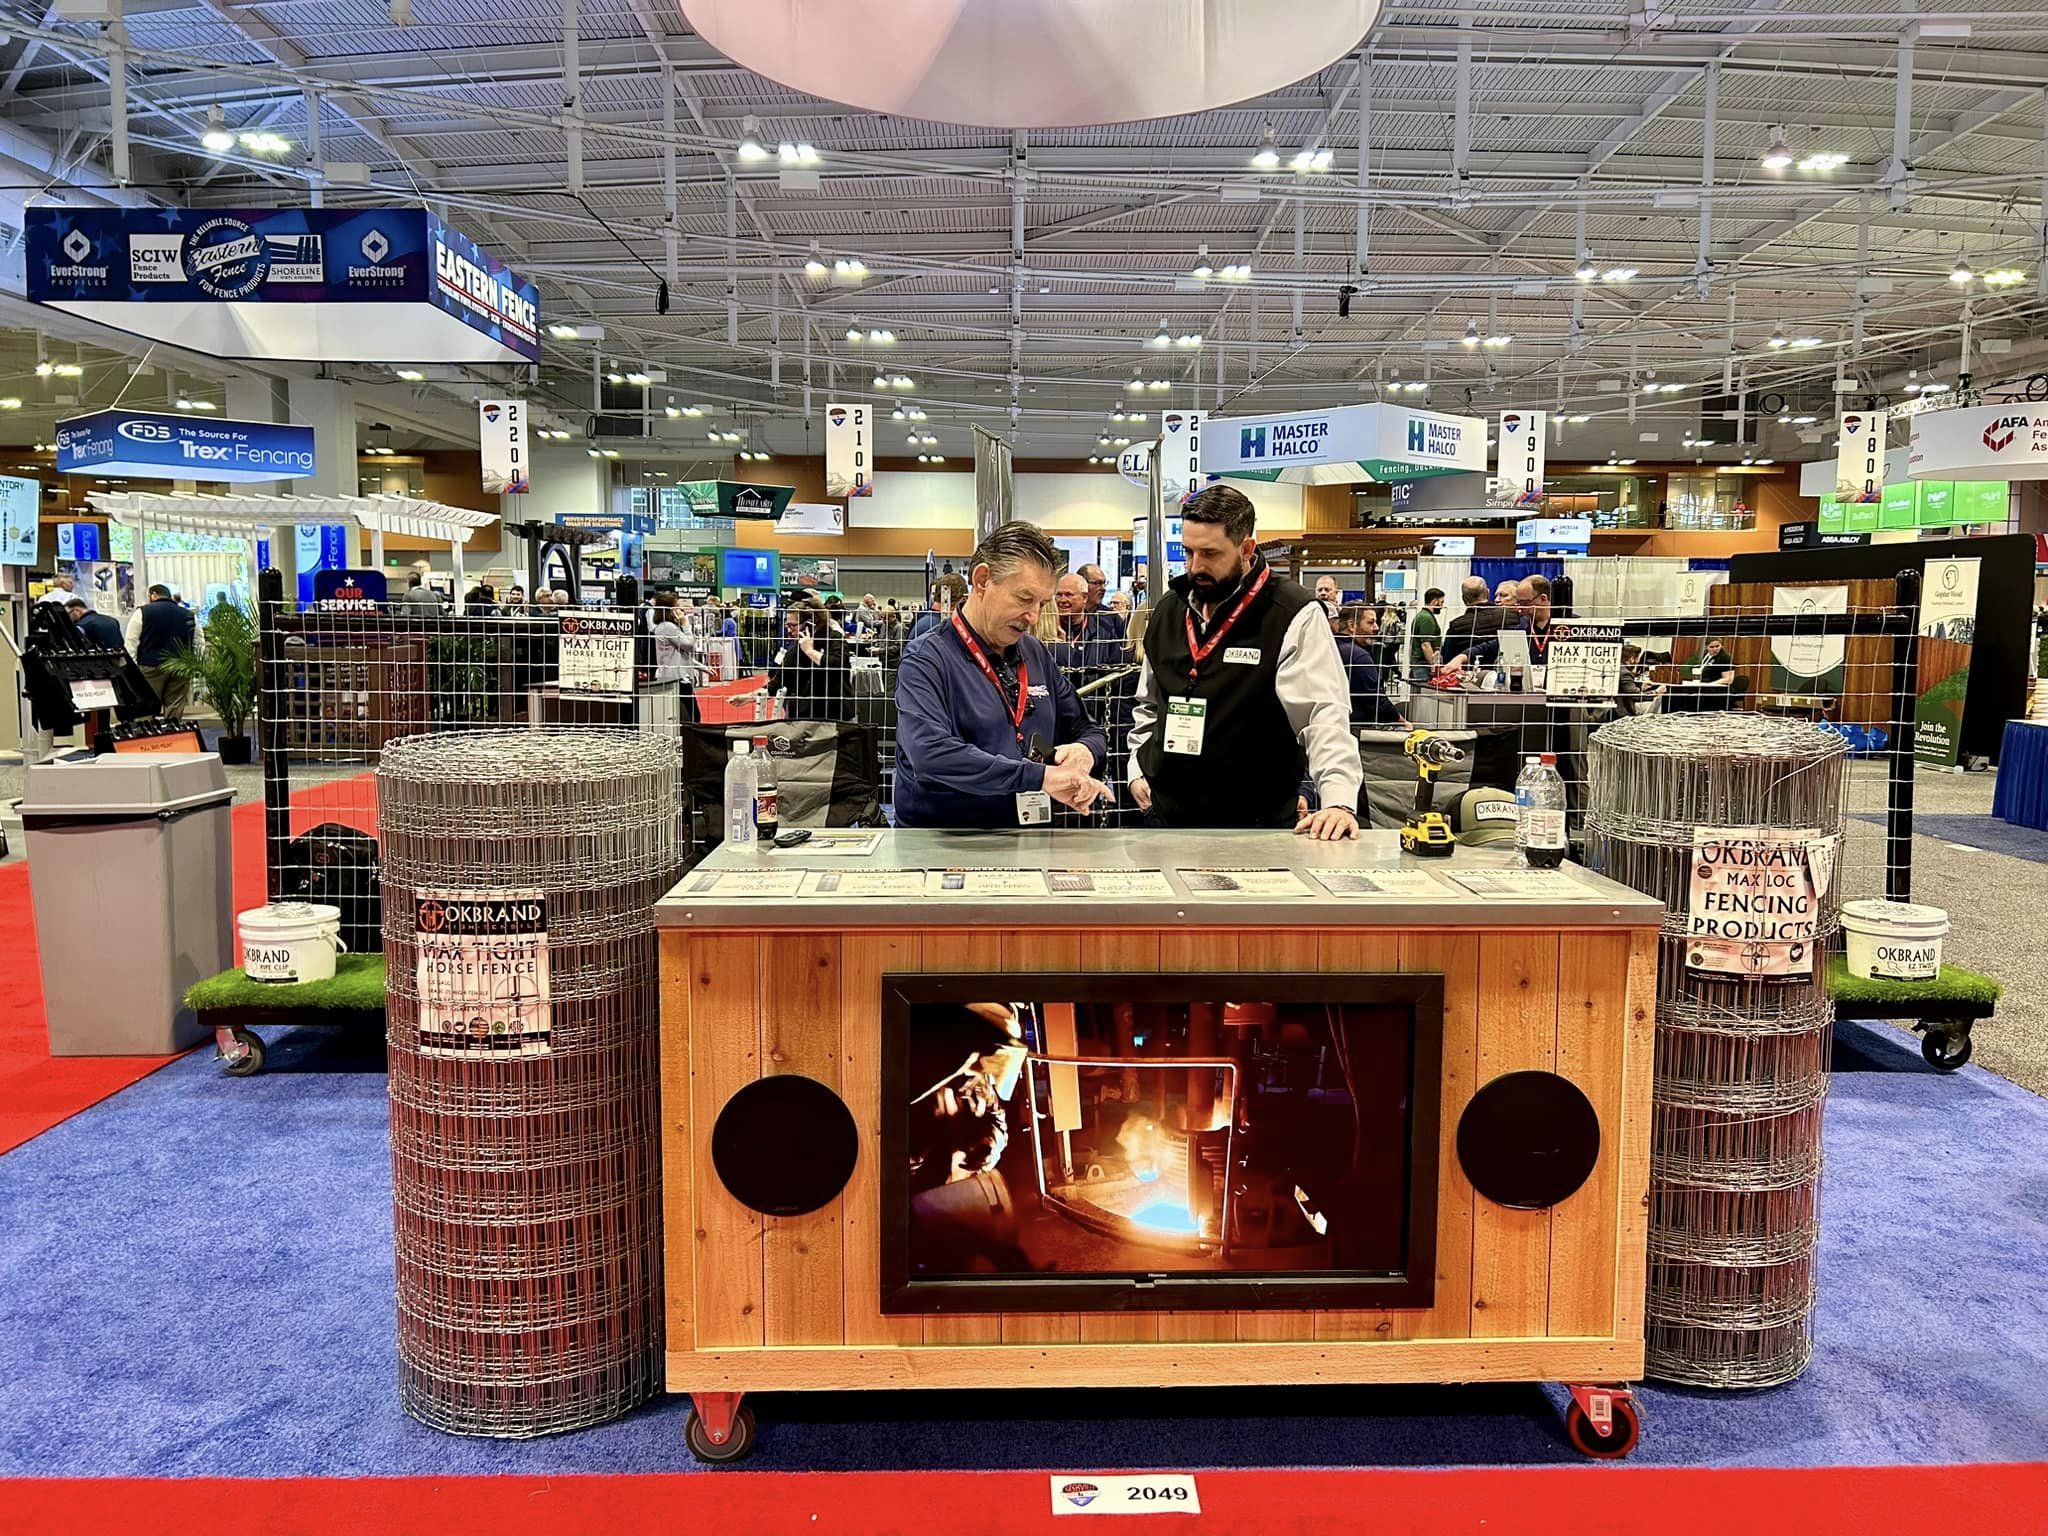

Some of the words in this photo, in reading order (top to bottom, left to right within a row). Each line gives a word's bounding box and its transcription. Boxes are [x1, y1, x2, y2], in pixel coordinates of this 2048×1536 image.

[224, 218, 249, 232] SOURCE
[132, 250, 178, 263] SCIW
[186, 239, 264, 276] Eastern
[133, 272, 170, 280] Products
[210, 264, 246, 283] Fence
[271, 267, 321, 276] SHORELINE
[199, 279, 214, 293] FOR
[214, 288, 239, 299] FENCE
[239, 263, 266, 296] PRODUCTS
[436, 240, 498, 312] EASTERN
[501, 285, 537, 334] FENCE
[2000, 417, 2028, 428] AFA
[132, 424, 170, 438] FDS
[179, 428, 196, 436] The
[199, 429, 230, 439] Source
[233, 433, 248, 441] For
[1273, 422, 1328, 440] MASTER
[1428, 423, 1461, 441] MASTER
[509, 405, 520, 484] 2200
[854, 409, 864, 488] 2100
[1272, 440, 1319, 456] HALCO
[1428, 440, 1456, 455] HALCO
[235, 444, 312, 469] Fencing
[1190, 415, 1199, 493] 2000
[1526, 415, 1536, 493] 1900
[1865, 416, 1877, 495] 1800
[335, 588, 362, 598] OUR
[320, 599, 376, 611] SERVICE
[580, 620, 632, 631] OKBRAND
[1571, 627, 1621, 637] OKBRAND
[564, 639, 590, 650] MAX
[595, 639, 629, 651] TIGHT
[1554, 646, 1579, 656] MAX
[1585, 646, 1618, 657] TIGHT
[600, 651, 626, 659] FENCE
[1920, 721, 1934, 731] Join
[1935, 722, 1947, 733] the
[1914, 732, 1950, 745] Revolution
[1477, 802, 1519, 816] OKBRAN
[1727, 873, 1761, 887] MAX
[1766, 873, 1795, 888] LOC
[1705, 892, 1808, 914] FENCING
[445, 905, 541, 922] OKBRAND
[1693, 918, 1813, 940] PRODUCTS
[422, 939, 464, 960] MAX
[472, 940, 539, 960] TIGHT
[1877, 946, 1936, 962] OKBRAND
[427, 962, 473, 975] HORSE
[482, 962, 535, 975] FENCE
[1127, 1487, 1188, 1501] 2049
